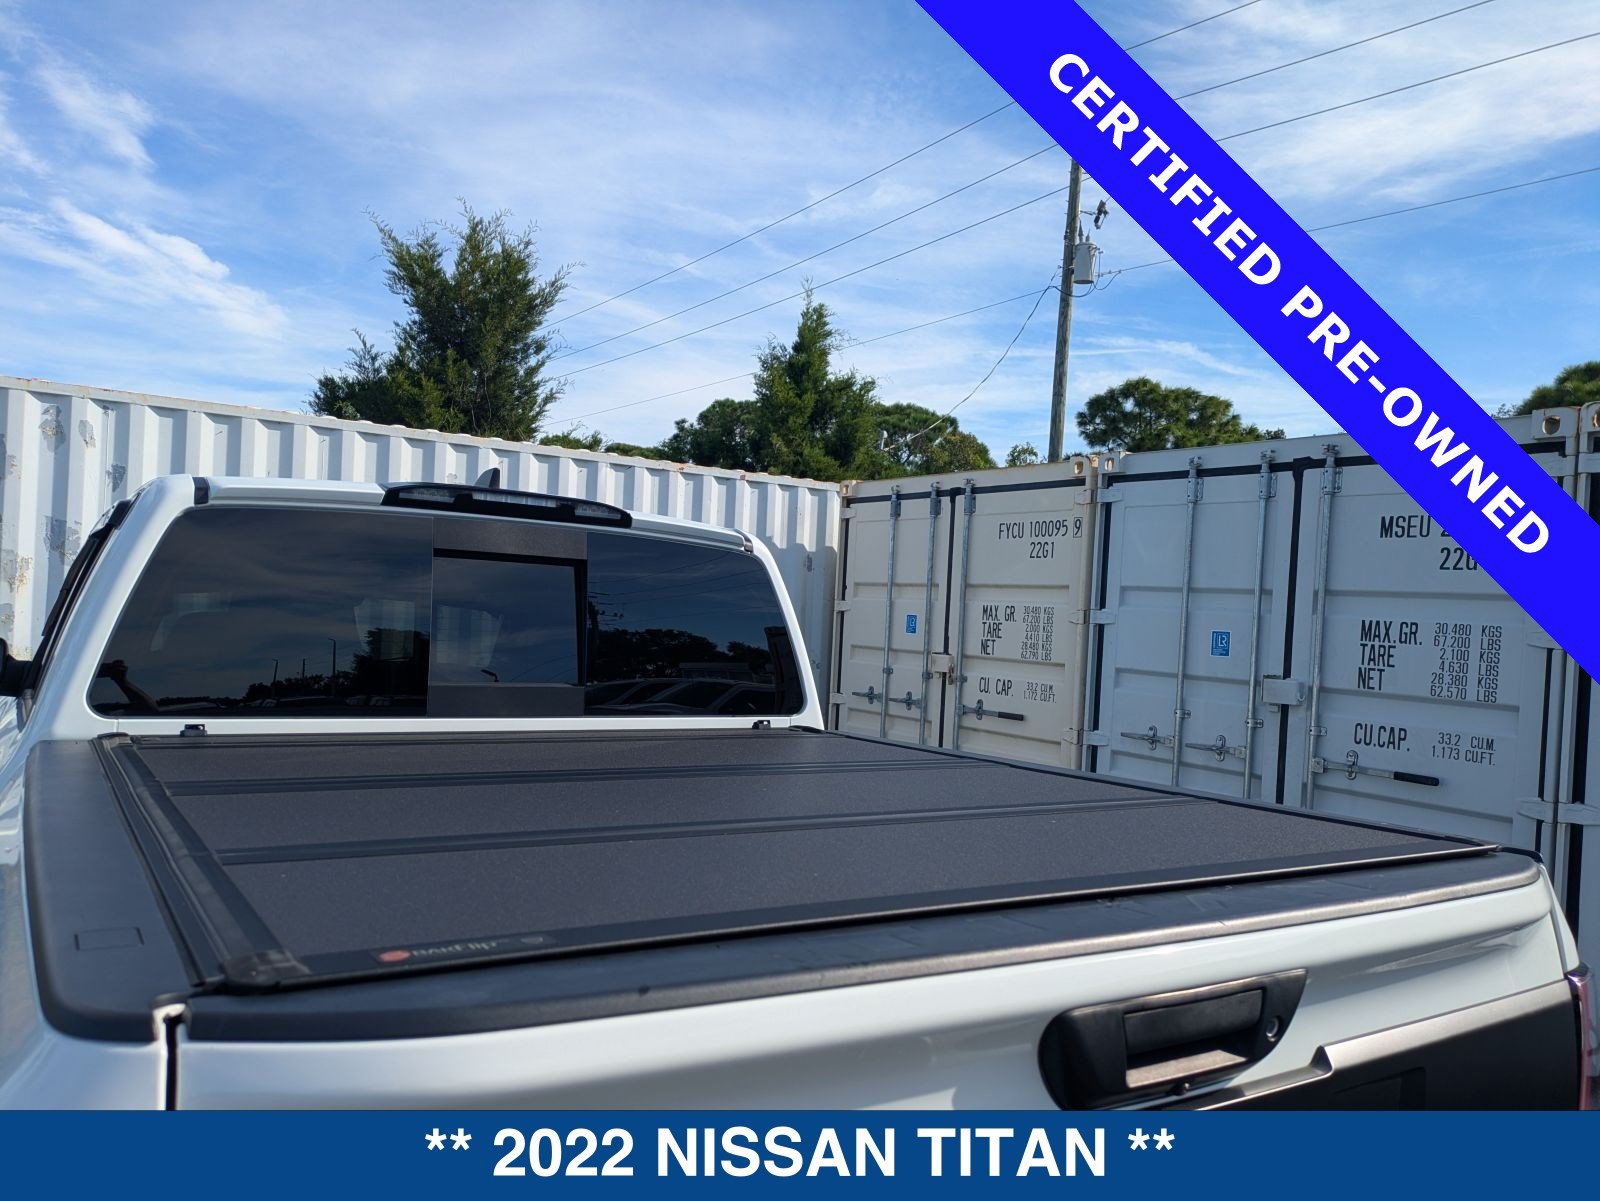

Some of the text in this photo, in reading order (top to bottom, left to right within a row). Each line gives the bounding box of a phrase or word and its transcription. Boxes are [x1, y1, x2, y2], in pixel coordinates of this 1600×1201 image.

[998, 518, 1082, 539] FYCU 100095 9
[1380, 515, 1431, 538] MSEU
[1029, 541, 1055, 559] 22G1
[1004, 605, 1016, 622] GR.
[1043, 606, 1055, 616] KGS
[1043, 615, 1054, 625] LBS
[982, 622, 1002, 639] TARE
[1042, 624, 1053, 634] KGS
[1041, 633, 1053, 643] LBS
[1434, 622, 1472, 636] 30.480
[1481, 625, 1502, 638] KGS
[980, 639, 996, 655] NET
[1041, 642, 1052, 652] KGS
[1433, 635, 1501, 651] 67.200 LBS
[1041, 652, 1052, 661] LBS
[1360, 643, 1500, 668] TARE 2.100 KGS
[1438, 660, 1499, 677] 4.630 LBS
[1357, 666, 1498, 691] NET 28.380 KGS
[995, 678, 1013, 697] CAP.
[1430, 685, 1497, 703] 62.570 LBS
[1438, 732, 1461, 747] 33.2
[1431, 745, 1460, 761] 1.173
